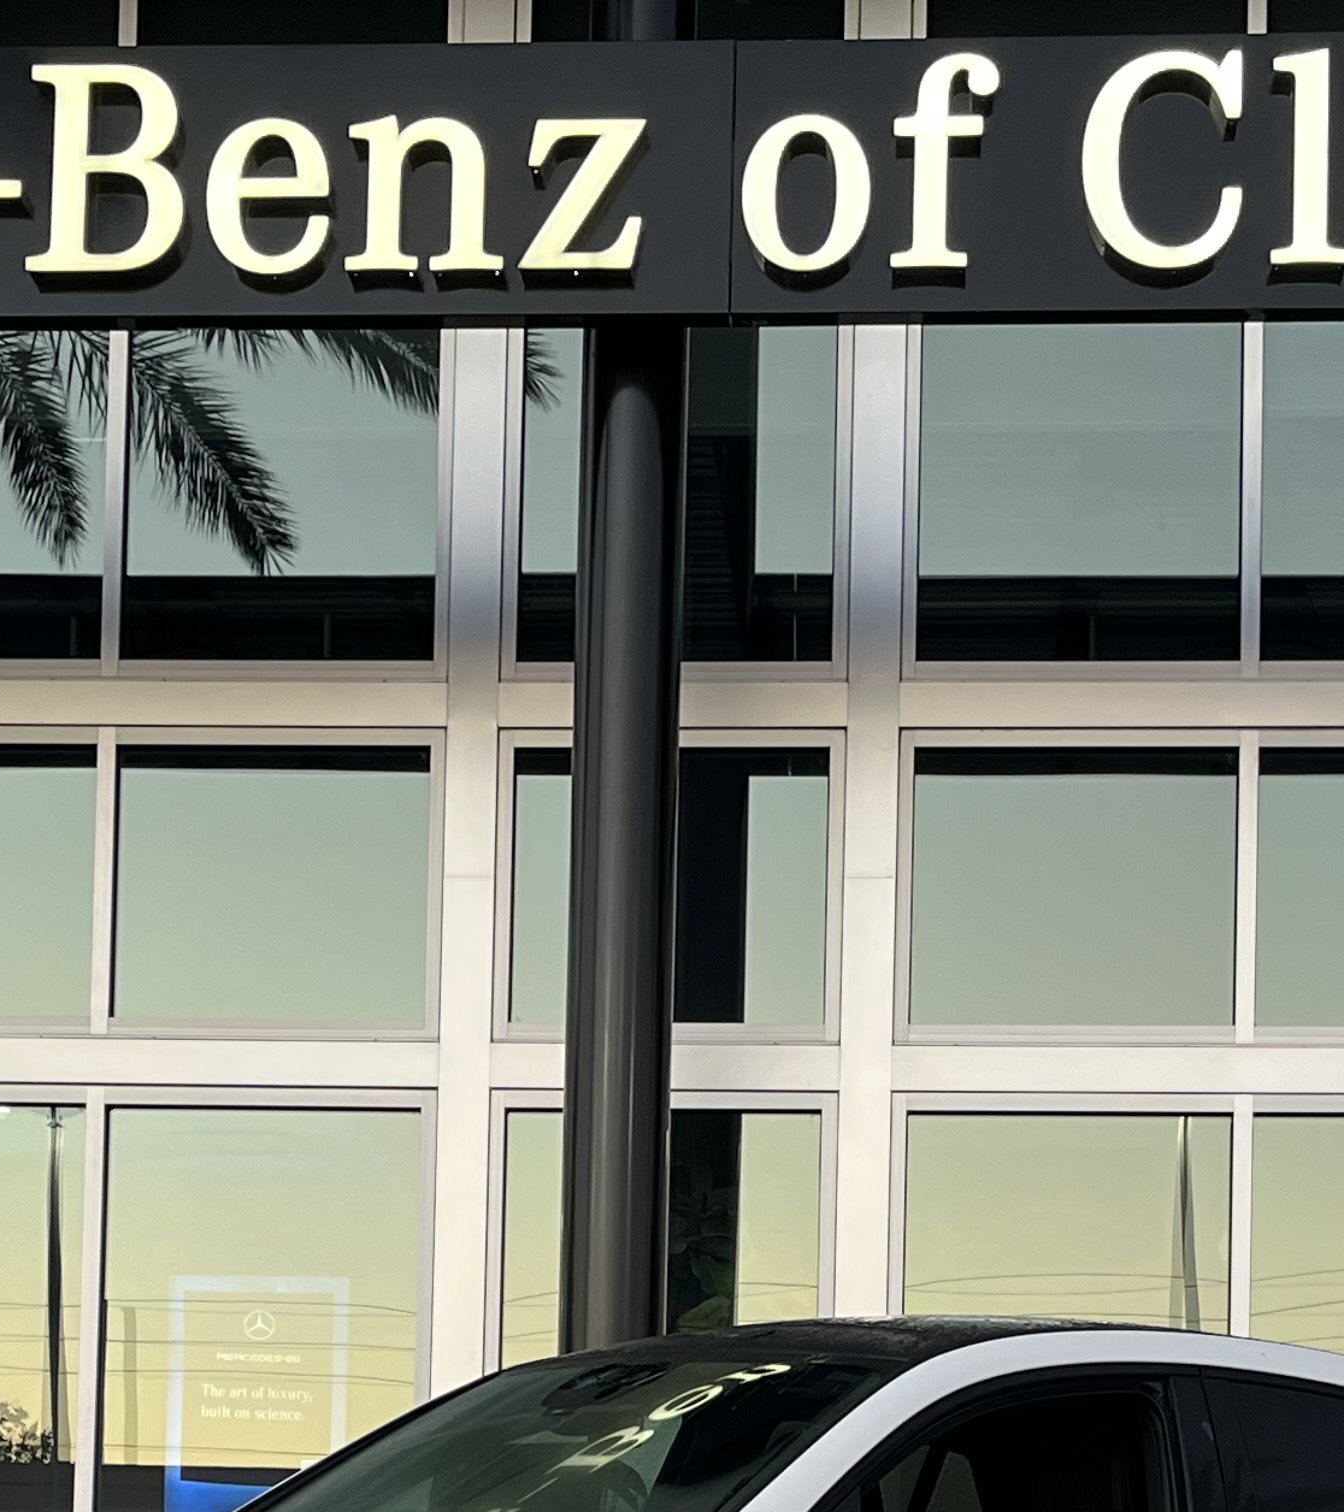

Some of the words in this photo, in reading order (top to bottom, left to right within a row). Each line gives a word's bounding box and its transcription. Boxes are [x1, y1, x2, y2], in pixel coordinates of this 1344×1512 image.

[742, 54, 999, 271] of
[202, 1383, 225, 1398] The
[229, 1387, 247, 1399] art
[251, 1386, 265, 1399] of
[267, 1386, 312, 1403] luxury,
[201, 1404, 230, 1418] built
[234, 1408, 250, 1419] on
[255, 1407, 305, 1421] science.
